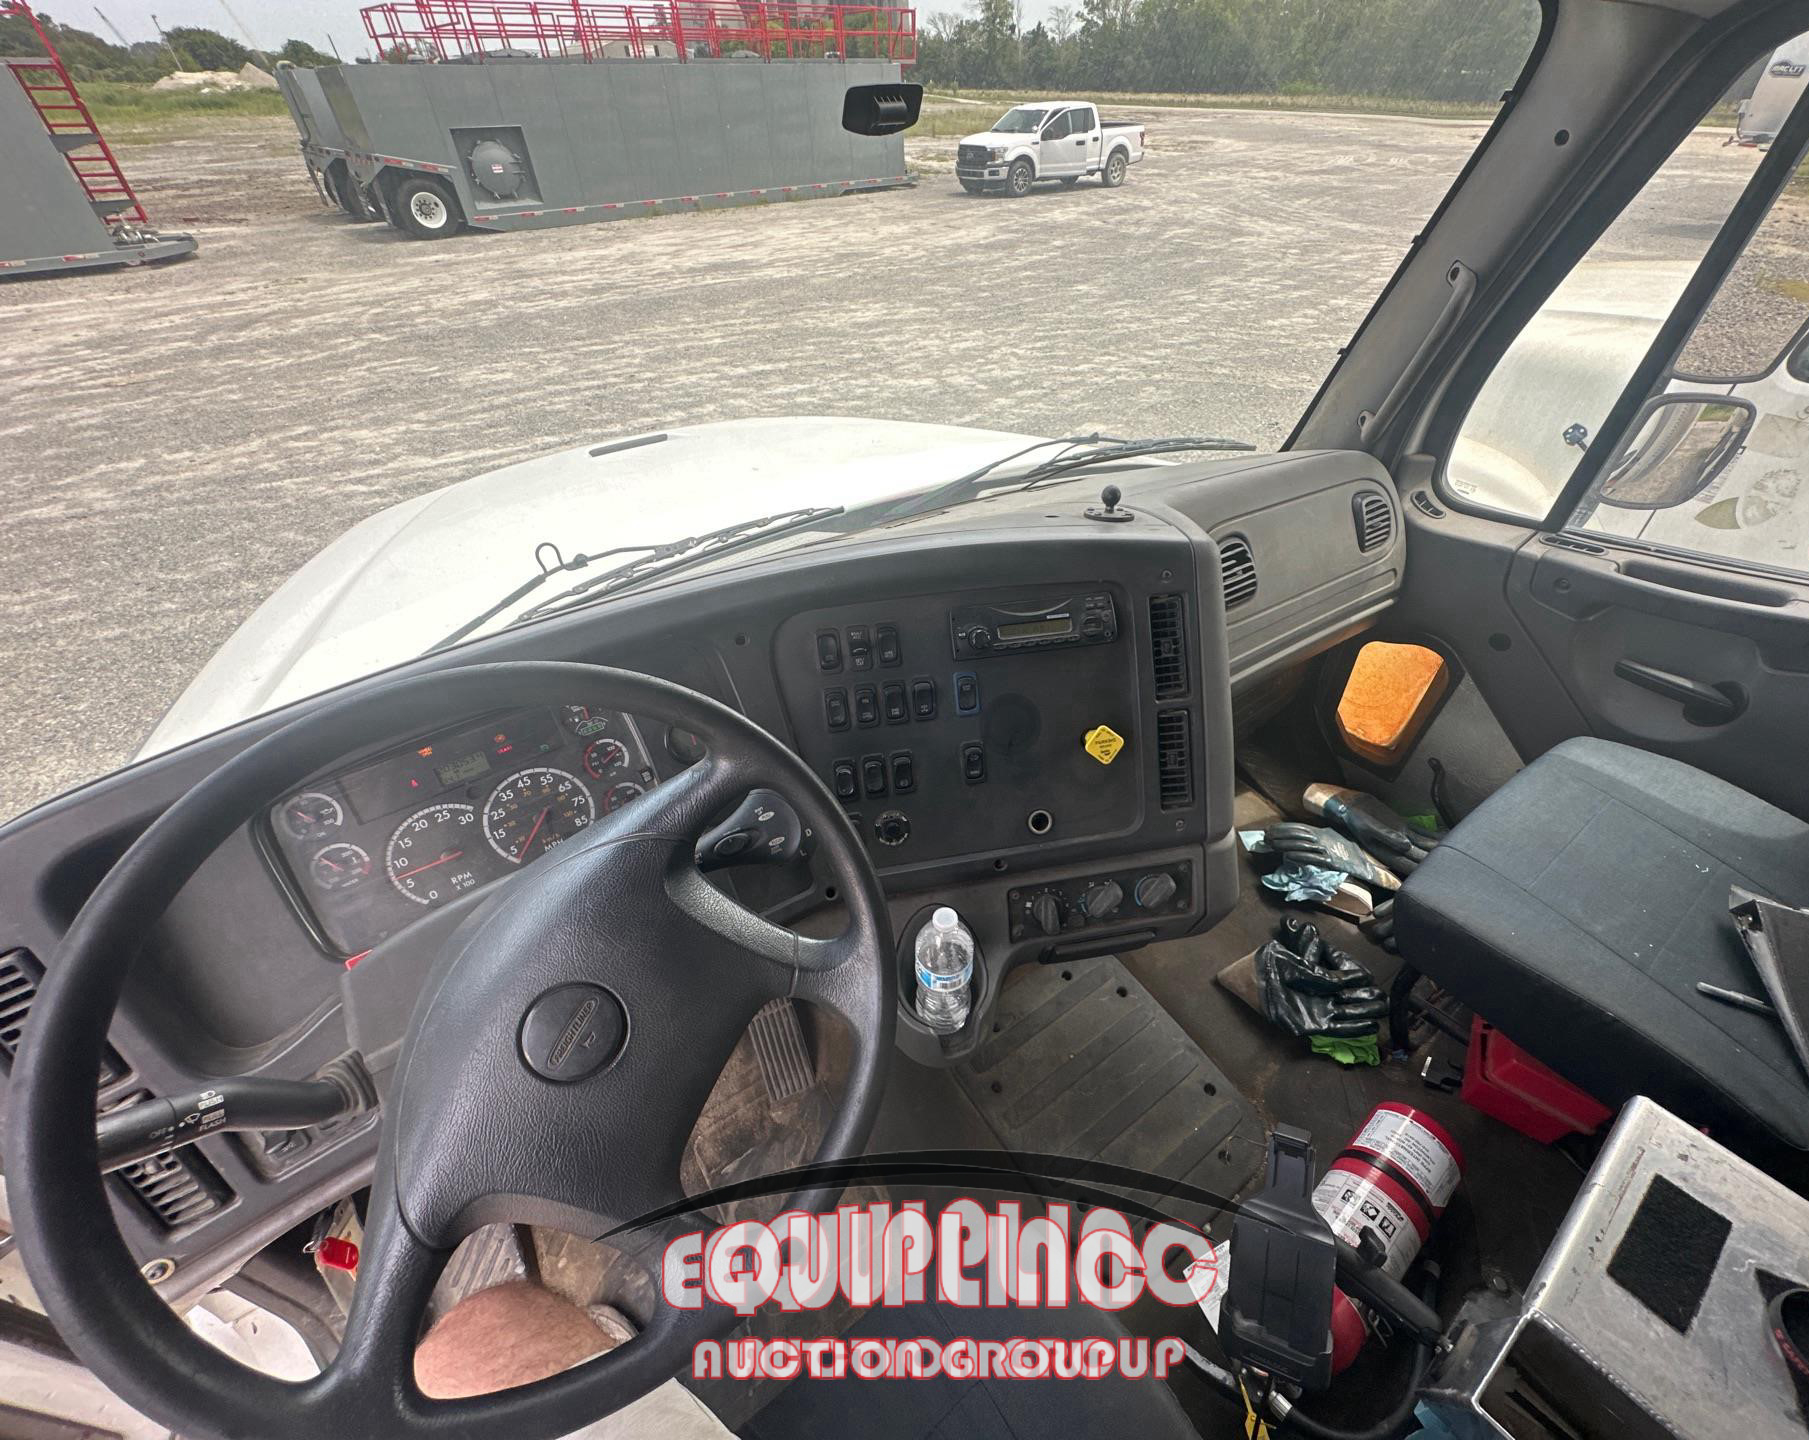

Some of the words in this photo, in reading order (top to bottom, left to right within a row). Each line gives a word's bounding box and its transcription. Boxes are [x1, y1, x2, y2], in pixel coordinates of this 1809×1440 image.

[517, 776, 531, 788] 45
[540, 774, 554, 786] 55
[559, 781, 572, 792] 65
[499, 790, 514, 801] 35
[571, 796, 585, 807] 75
[434, 810, 451, 823] 25
[458, 813, 474, 825] 30
[490, 808, 506, 820] 25
[412, 819, 428, 832] 20
[574, 815, 588, 827] 85
[493, 829, 506, 840] 15
[398, 837, 413, 849] 15
[510, 845, 518, 855] 5
[393, 857, 409, 869] 10
[406, 878, 415, 888] 5
[450, 871, 473, 885] RPM
[463, 878, 476, 888] 100
[429, 890, 438, 899] 0
